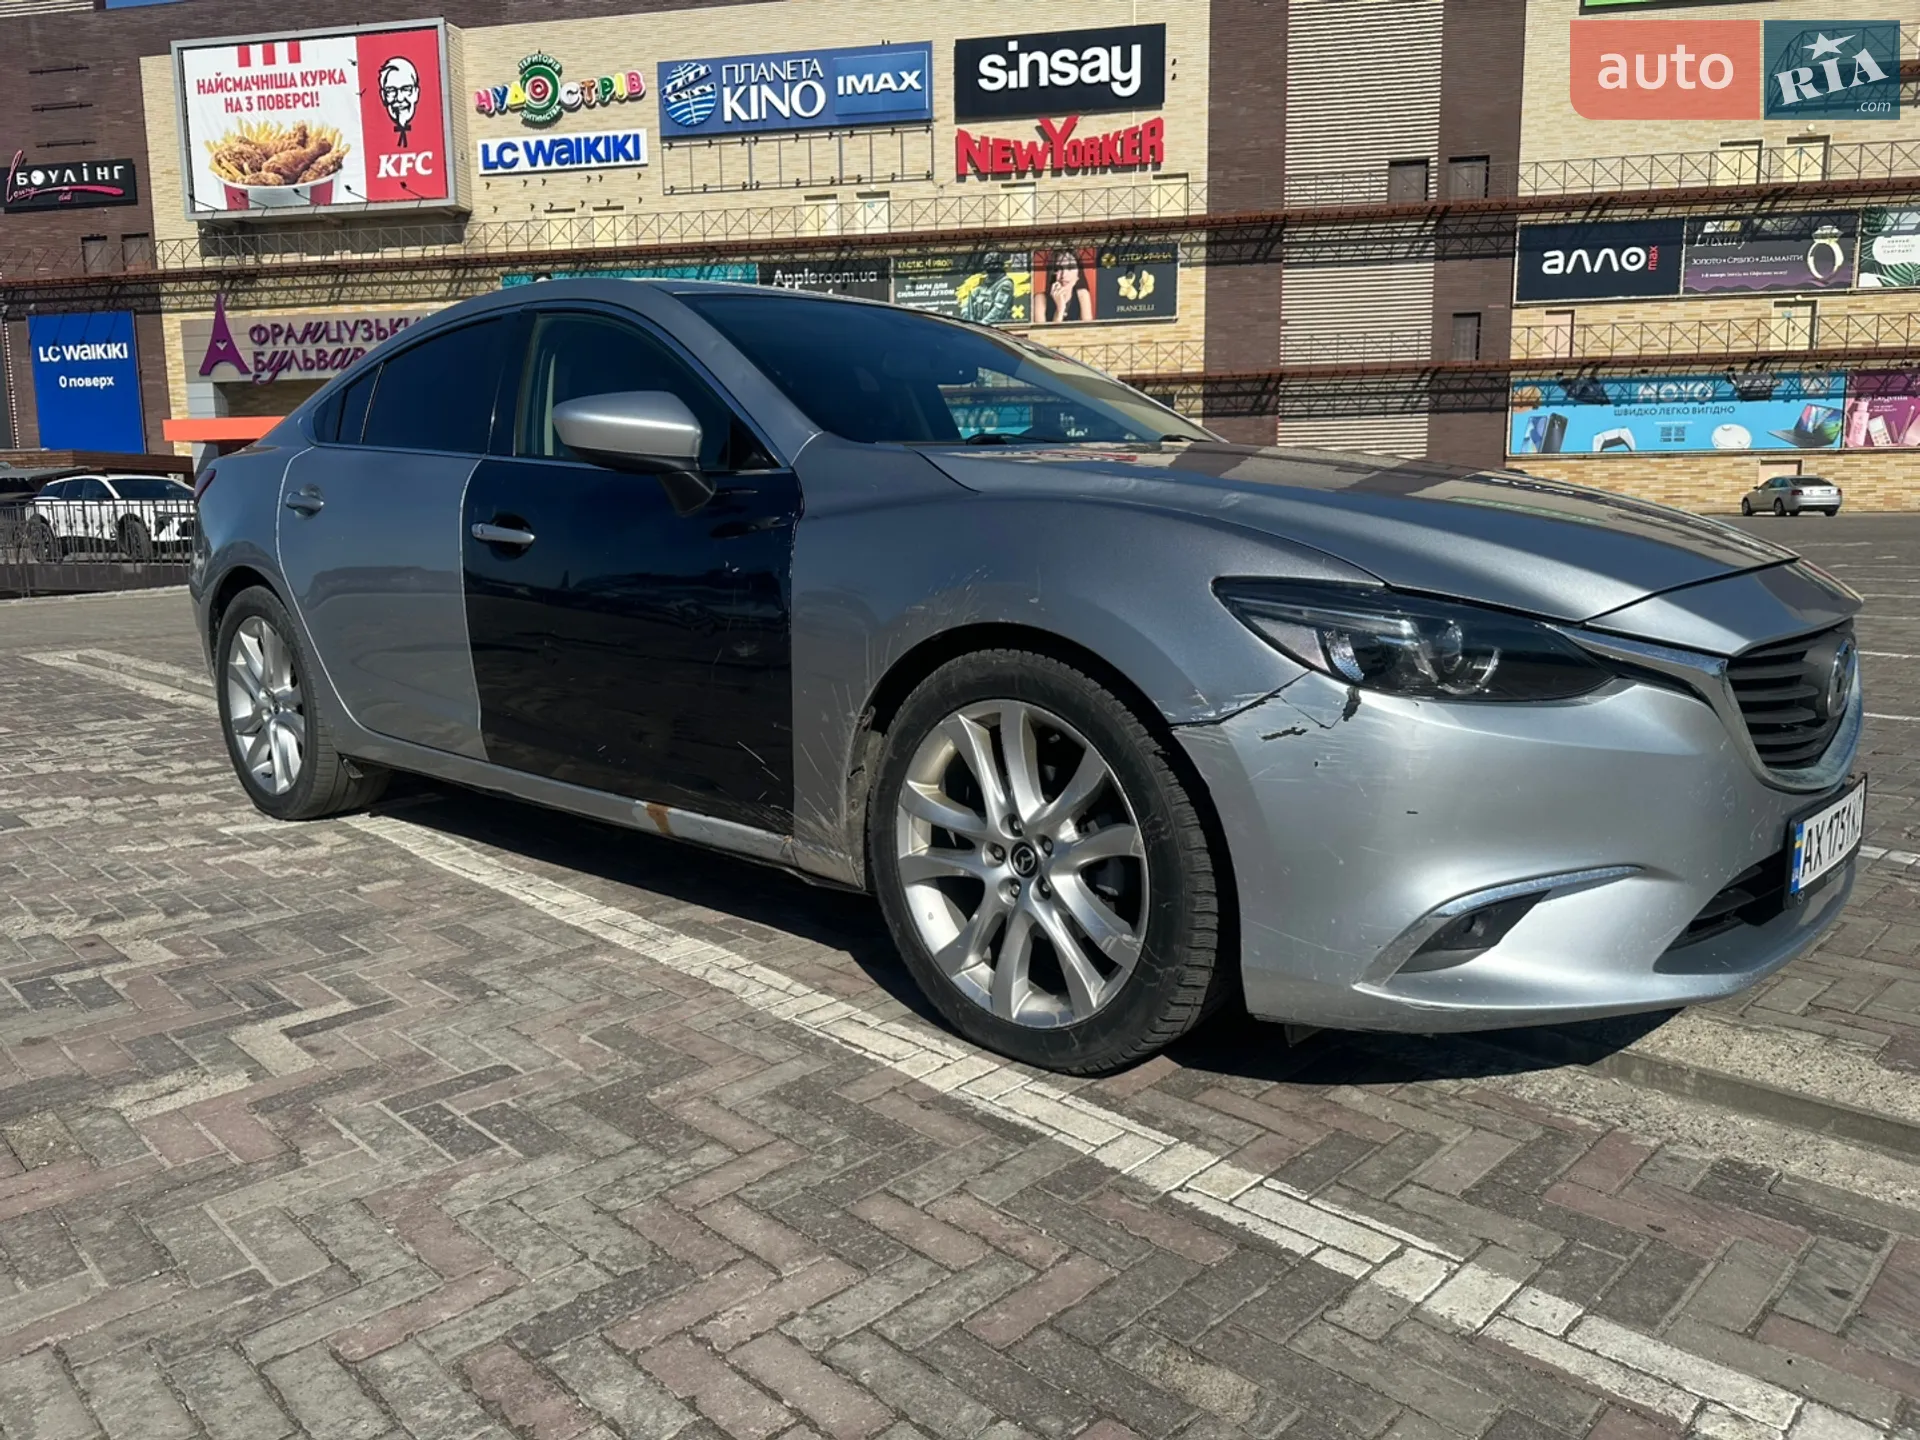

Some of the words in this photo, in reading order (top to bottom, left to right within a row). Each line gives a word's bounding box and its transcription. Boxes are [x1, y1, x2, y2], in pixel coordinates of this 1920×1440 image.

[196, 72, 298, 94] НАЙСМАЧНІША
[300, 68, 347, 87] КУРКА
[977, 40, 1142, 97] sinsay
[837, 70, 923, 96] IMAX
[224, 96, 243, 113] НА
[245, 96, 254, 112] 3
[257, 91, 320, 111] ПОВЕРСІ!
[377, 151, 433, 178] KFC
[481, 142, 519, 170] LC
[1648, 245, 1659, 271] max
[772, 267, 878, 290] Appleroom.ua
[38, 346, 61, 362] LC
[59, 375, 67, 388] 0
[69, 376, 115, 389] поверх
[1614, 408, 1657, 416] ШВИДКО
[1659, 407, 1690, 415] ЛЕГКО
[1692, 405, 1735, 415] ВИГІДНО
[1801, 819, 1826, 878] AX
